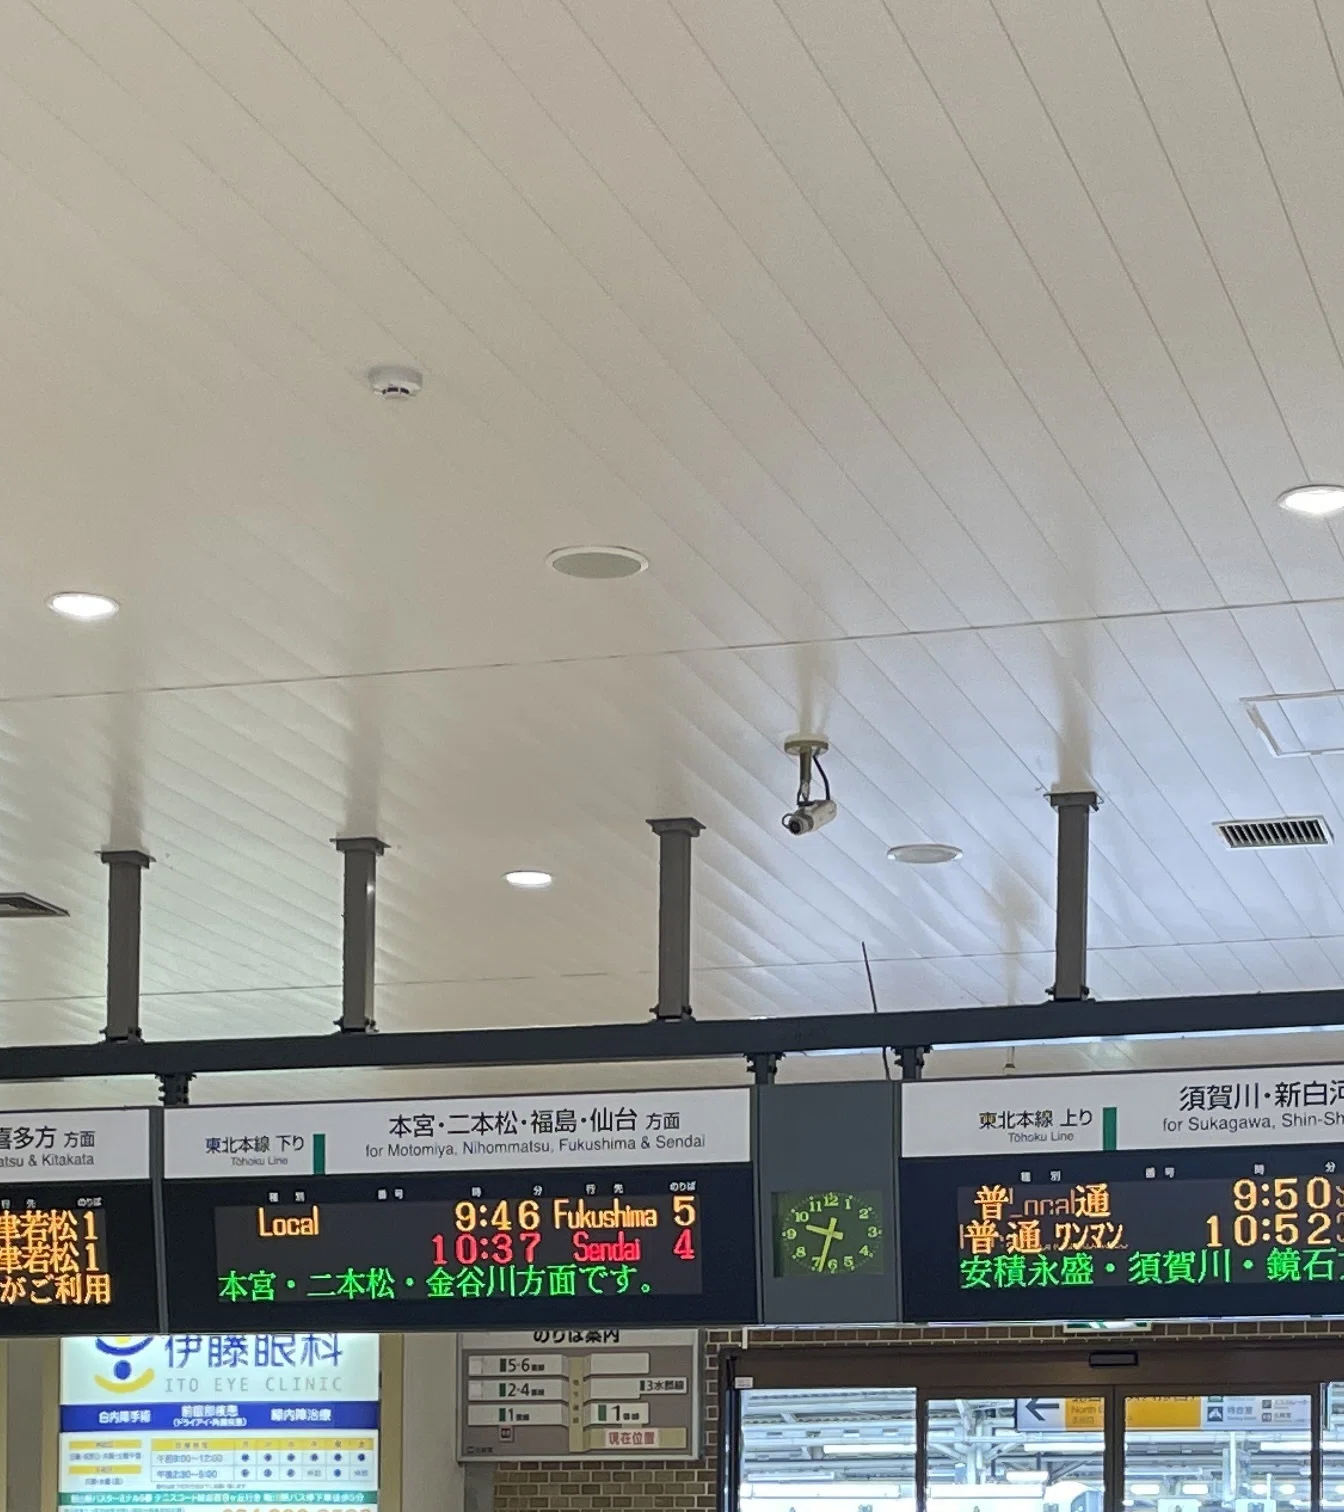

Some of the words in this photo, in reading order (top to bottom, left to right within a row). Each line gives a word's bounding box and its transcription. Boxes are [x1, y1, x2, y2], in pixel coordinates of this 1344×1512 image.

[645, 1111, 680, 1132] 方面
[979, 1110, 1053, 1130] 東北本線
[1060, 1108, 1093, 1127] 上り
[1163, 1118, 1182, 1132] for
[1188, 1115, 1276, 1134] Sukagawa,
[64, 1130, 96, 1149] 方面
[205, 1136, 270, 1154] 東北本線
[275, 1135, 305, 1152] 下り
[366, 1143, 382, 1157] for
[559, 1136, 636, 1152] Fukushima
[641, 1135, 651, 1149] &
[656, 1133, 705, 1149] Sendai
[28, 1154, 37, 1167] &
[42, 1152, 95, 1167] Kitakata
[1232, 1175, 1332, 1212] 9:50
[84, 1210, 98, 1240] 1
[258, 1206, 320, 1237] Local
[454, 1201, 541, 1232] 9:46
[554, 1199, 657, 1230] Fukushima
[672, 1196, 696, 1226] 5
[1206, 1210, 1332, 1247] 10:52
[84, 1242, 99, 1272] 1
[432, 1232, 541, 1265] 10:37
[572, 1232, 641, 1262] Sendai
[672, 1230, 696, 1260] 4
[165, 1376, 199, 1393] ITO
[214, 1376, 249, 1392] EYE
[265, 1376, 343, 1392] CLINIC
